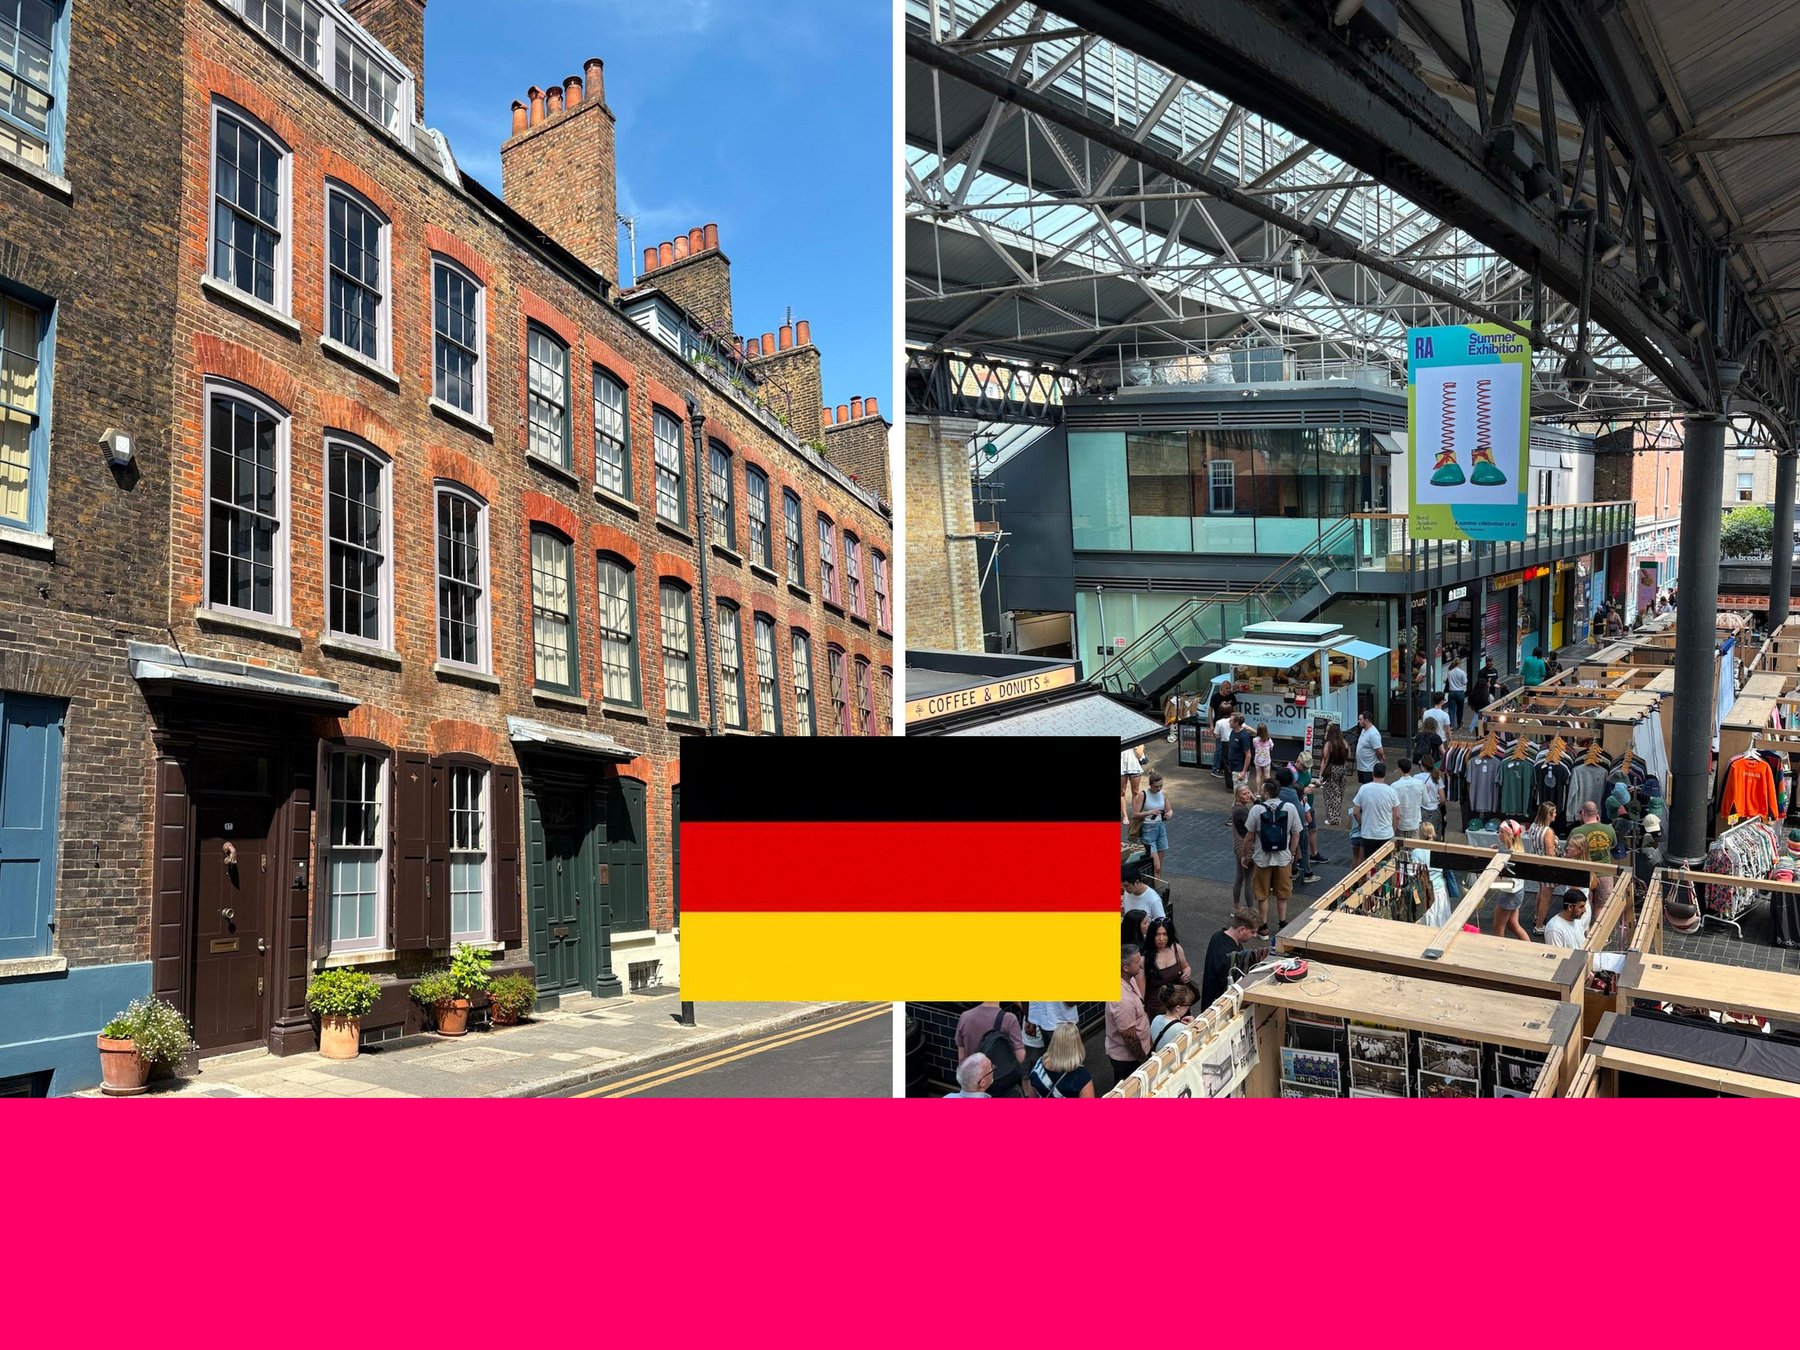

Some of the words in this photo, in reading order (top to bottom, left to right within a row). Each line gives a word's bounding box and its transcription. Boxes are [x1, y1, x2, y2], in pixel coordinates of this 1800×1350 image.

[1469, 333, 1516, 344] Summer
[1415, 336, 1434, 359] RA
[1468, 344, 1523, 355] Exhibition
[928, 691, 976, 714] COFFEE
[984, 688, 992, 702] &
[999, 676, 1041, 697] DONUTS
[1237, 702, 1260, 715] TRE
